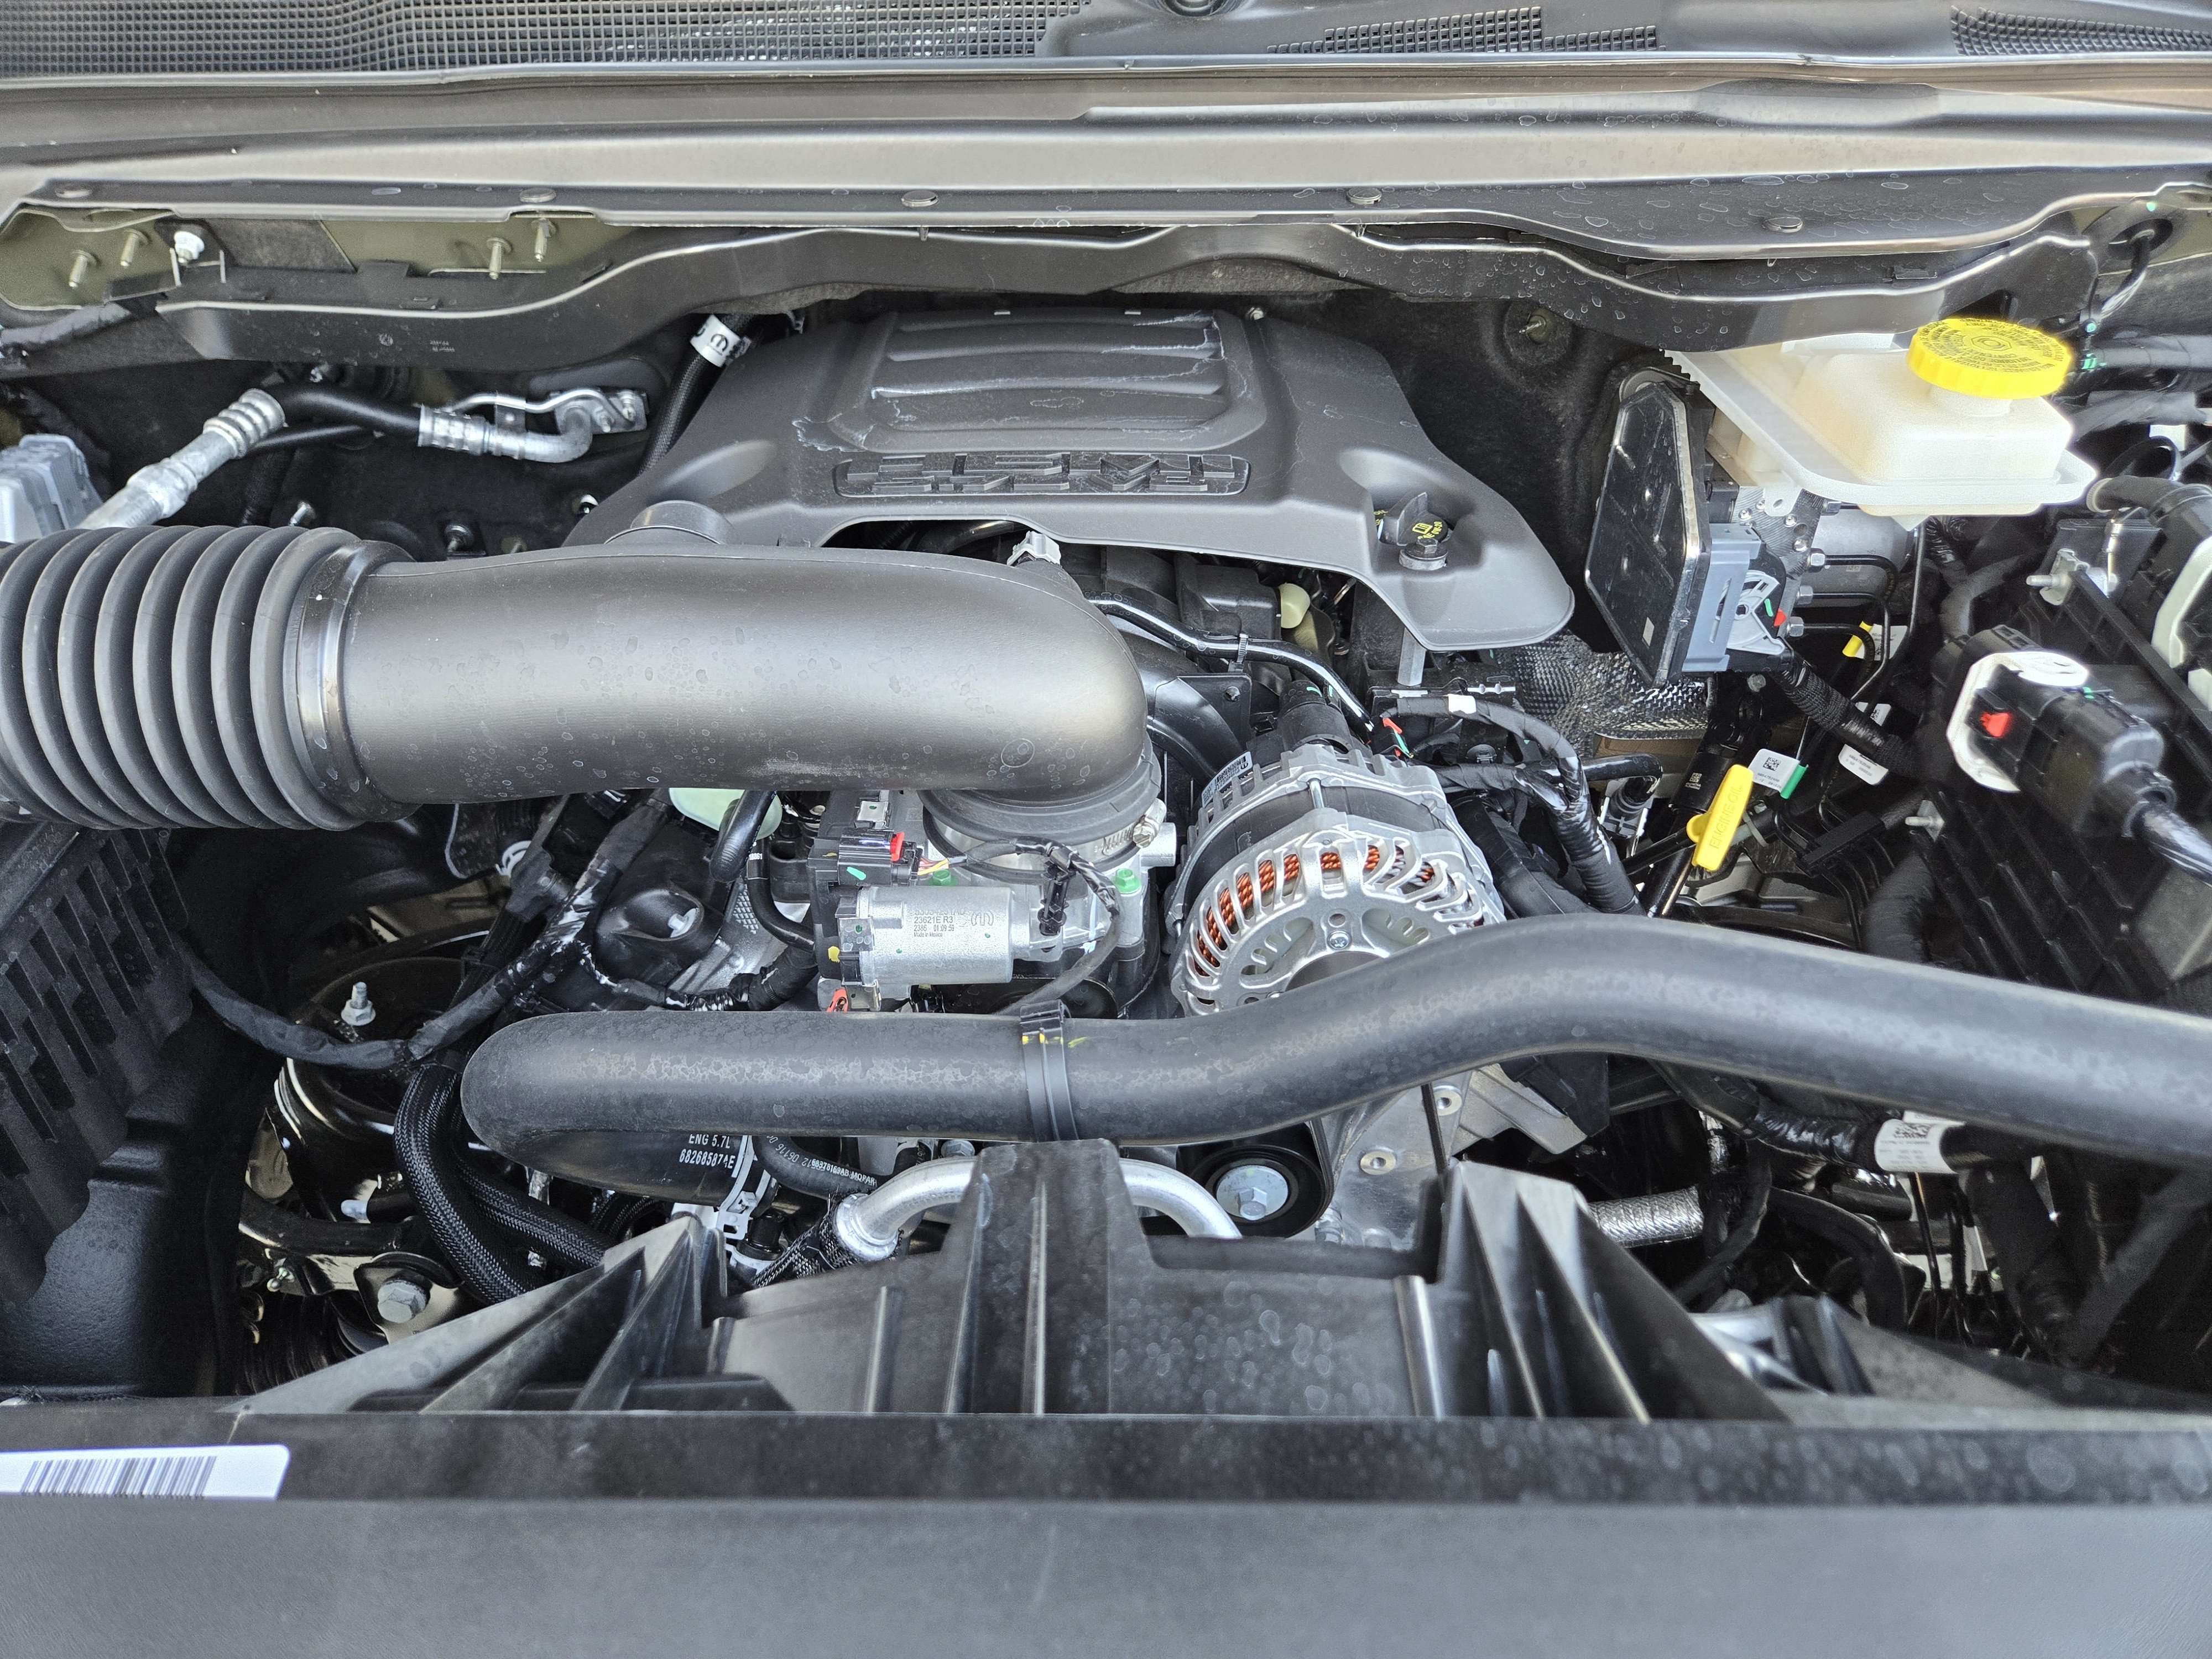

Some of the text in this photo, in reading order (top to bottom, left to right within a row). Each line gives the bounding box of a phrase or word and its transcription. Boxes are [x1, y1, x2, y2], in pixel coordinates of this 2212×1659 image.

[914, 916, 941, 924] 23621E
[688, 1134, 730, 1149] ENG 5.7L
